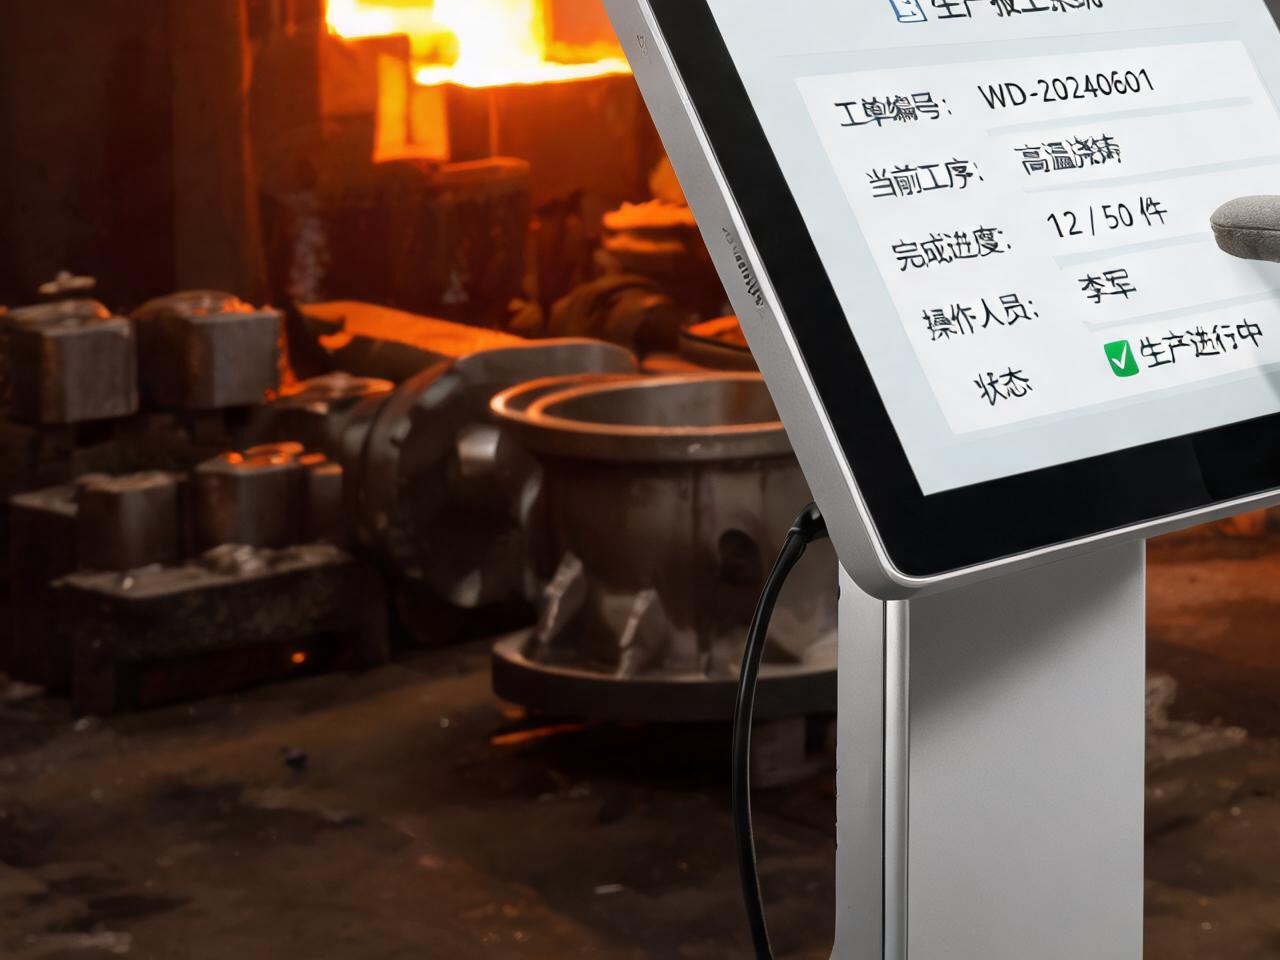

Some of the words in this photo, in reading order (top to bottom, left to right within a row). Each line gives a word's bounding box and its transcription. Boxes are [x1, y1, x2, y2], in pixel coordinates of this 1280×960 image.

[977, 68, 1154, 110] WD-20240601
[1140, 318, 1263, 368] 生产进行中
